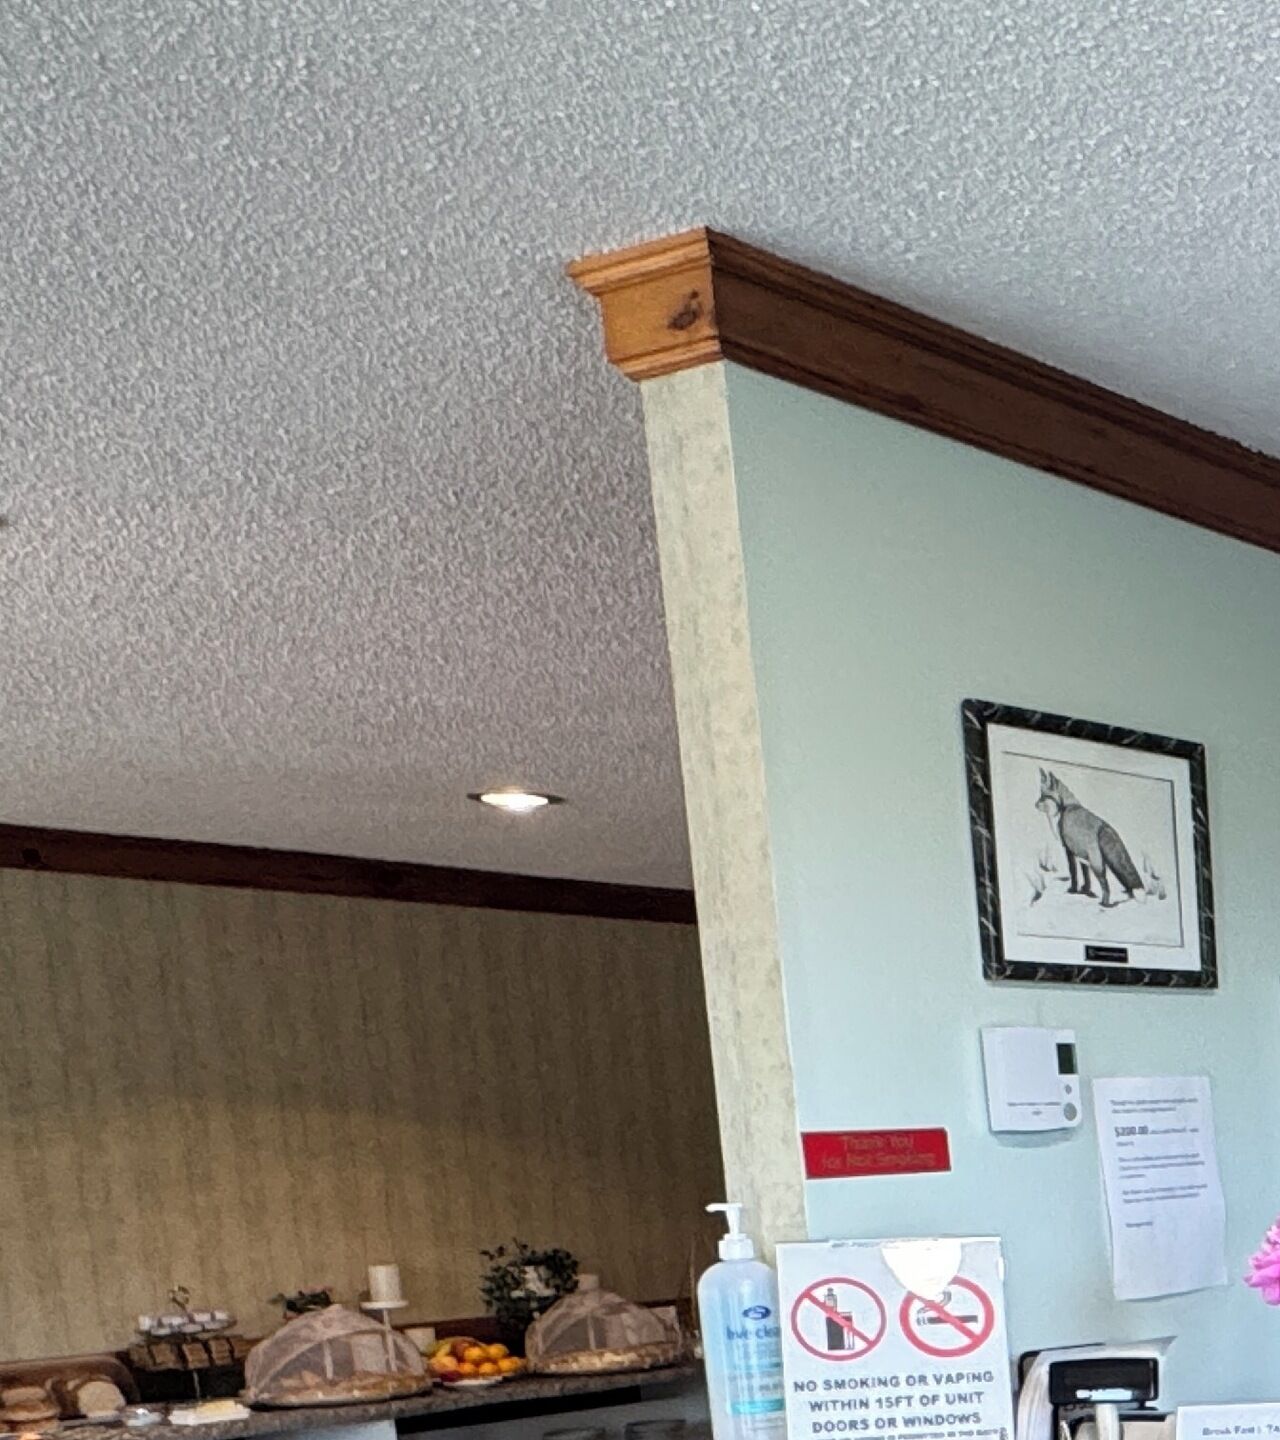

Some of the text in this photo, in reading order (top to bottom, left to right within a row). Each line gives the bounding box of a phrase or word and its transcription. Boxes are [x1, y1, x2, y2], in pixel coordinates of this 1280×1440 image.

[793, 1370, 995, 1393] NO SMOKING OR VAPING
[809, 1390, 985, 1413] WITHIN 15FT OF UNIT
[812, 1411, 982, 1434] DOORS OR WINDOWS
